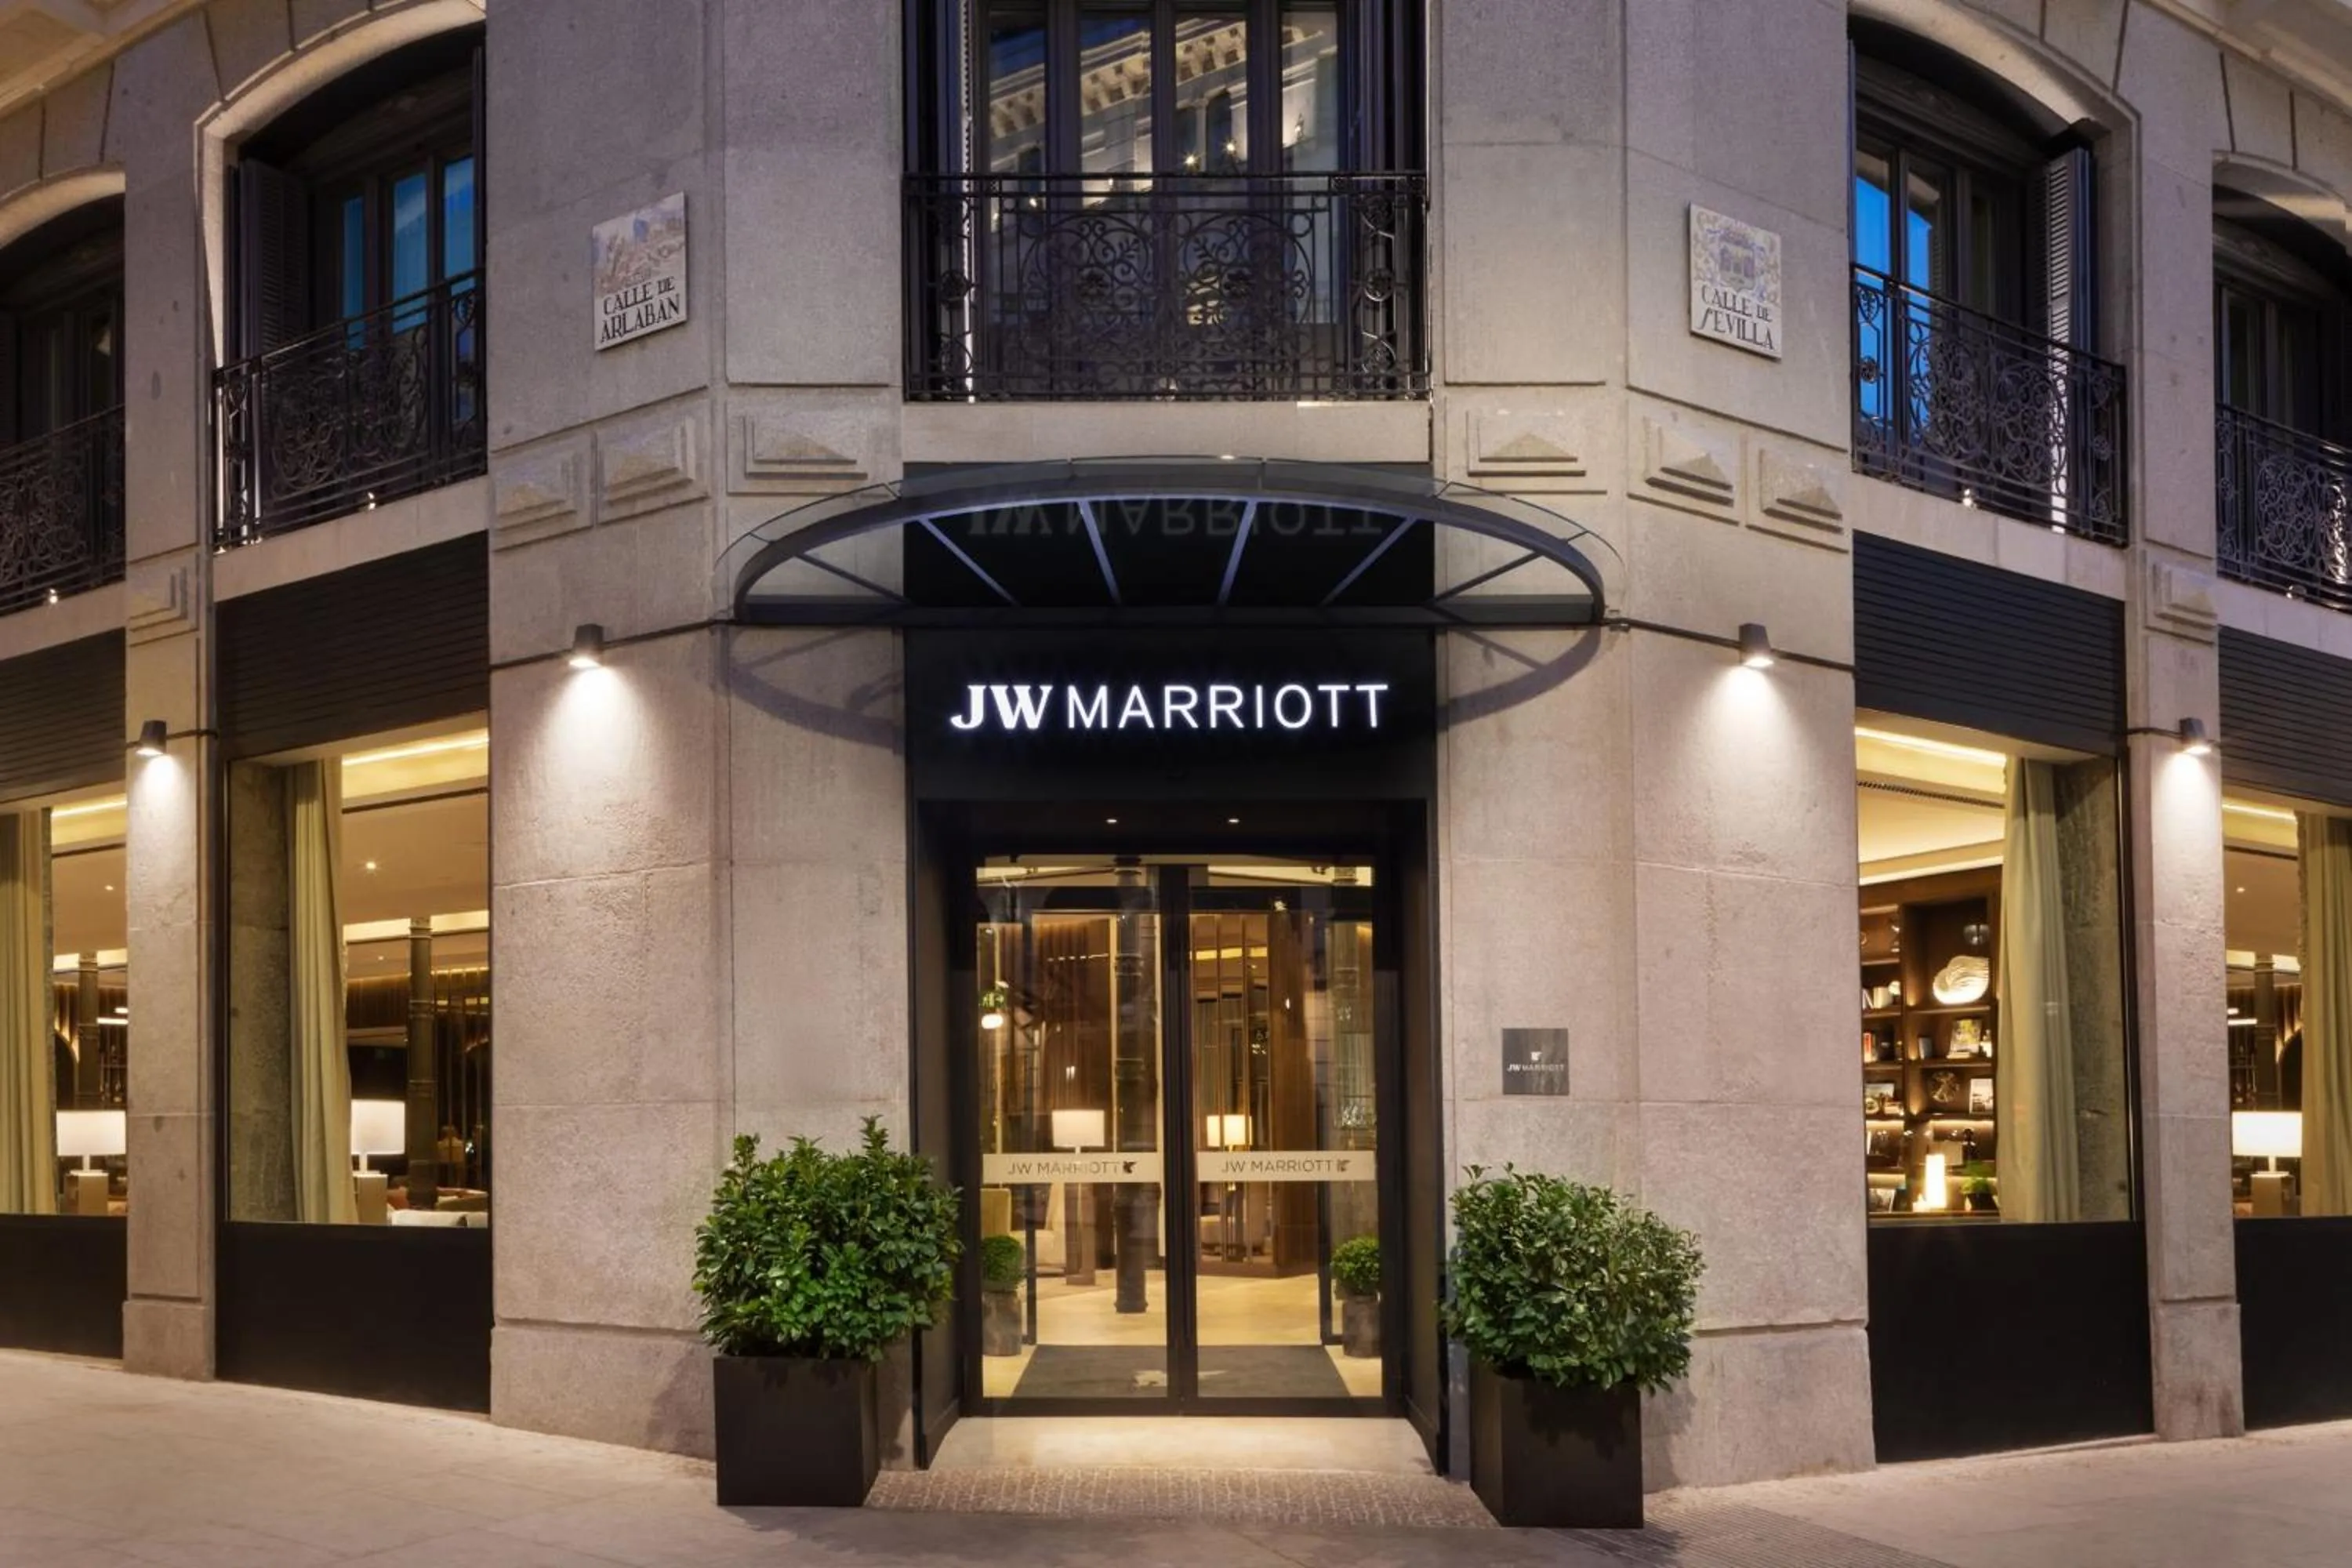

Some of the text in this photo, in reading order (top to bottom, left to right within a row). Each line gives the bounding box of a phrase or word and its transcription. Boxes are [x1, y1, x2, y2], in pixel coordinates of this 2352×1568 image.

[603, 276, 675, 315] CALLE DE
[1701, 285, 1773, 322] CALLE DE
[601, 293, 681, 343] ARLABAN
[1697, 307, 1776, 350] SEVILLA
[950, 684, 1389, 730] JW MARRIOTT
[1008, 1161, 1120, 1174] JW MARRIOTT
[1221, 1160, 1332, 1173] JW MARRIOTT
